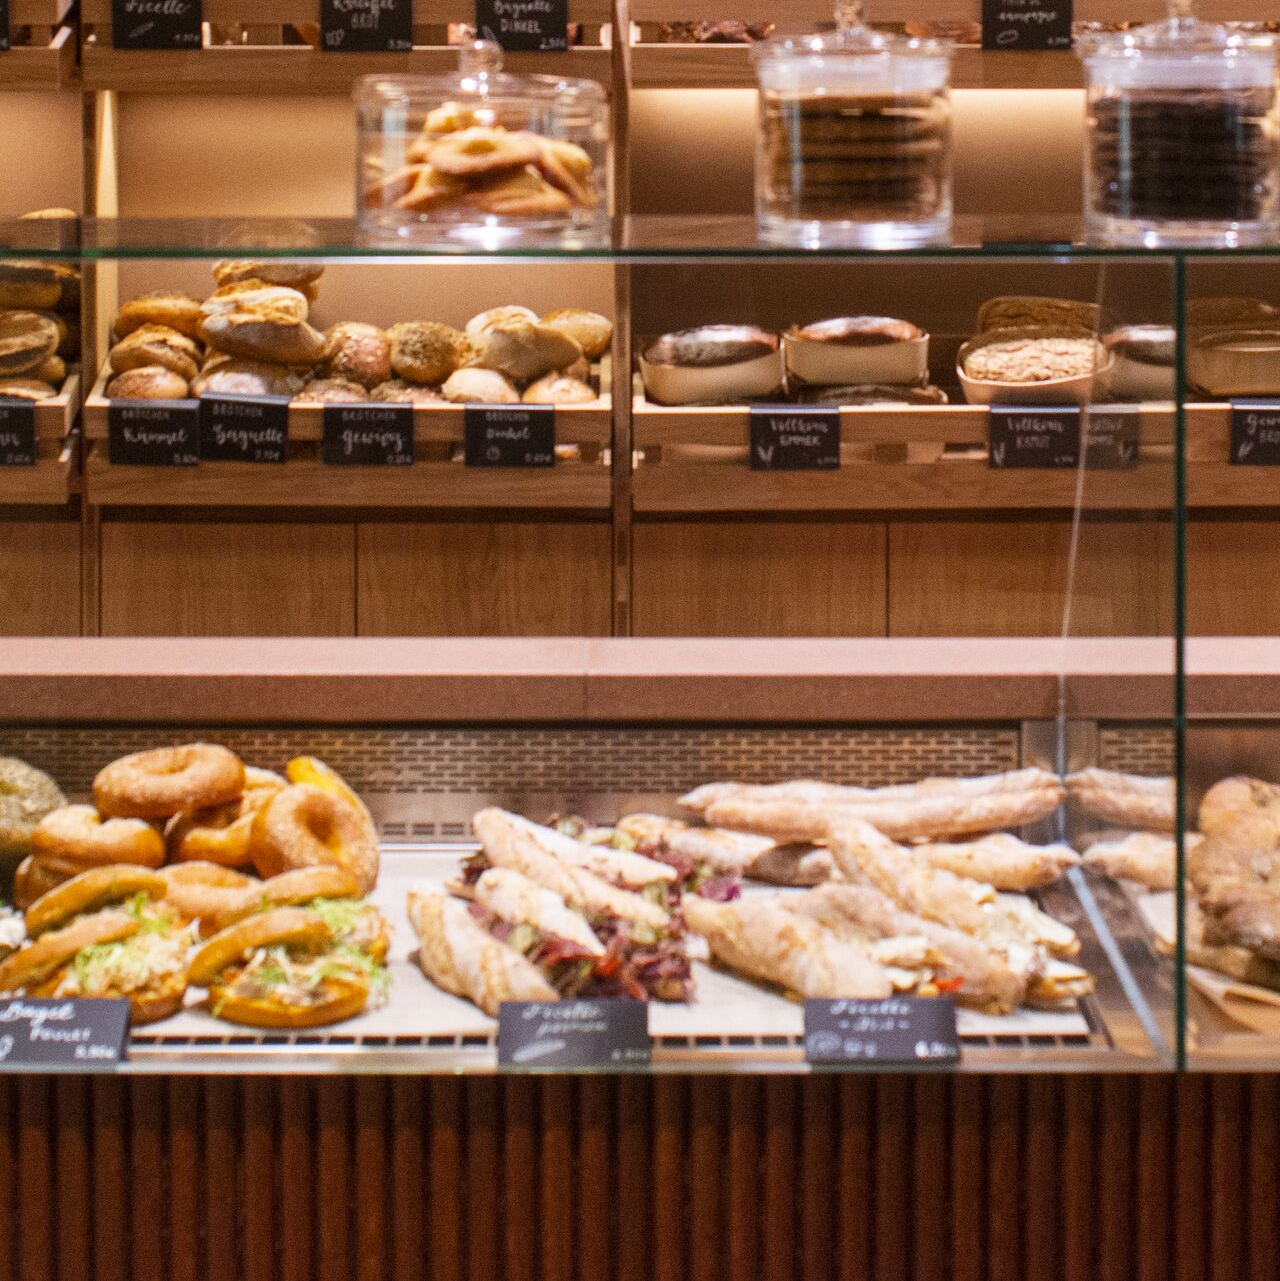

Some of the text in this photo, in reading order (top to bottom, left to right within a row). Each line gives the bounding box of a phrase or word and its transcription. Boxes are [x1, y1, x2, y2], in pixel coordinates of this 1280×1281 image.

[494, 0, 554, 19] Baguette
[499, 18, 542, 34] DINKEL
[212, 423, 284, 451] Baguette
